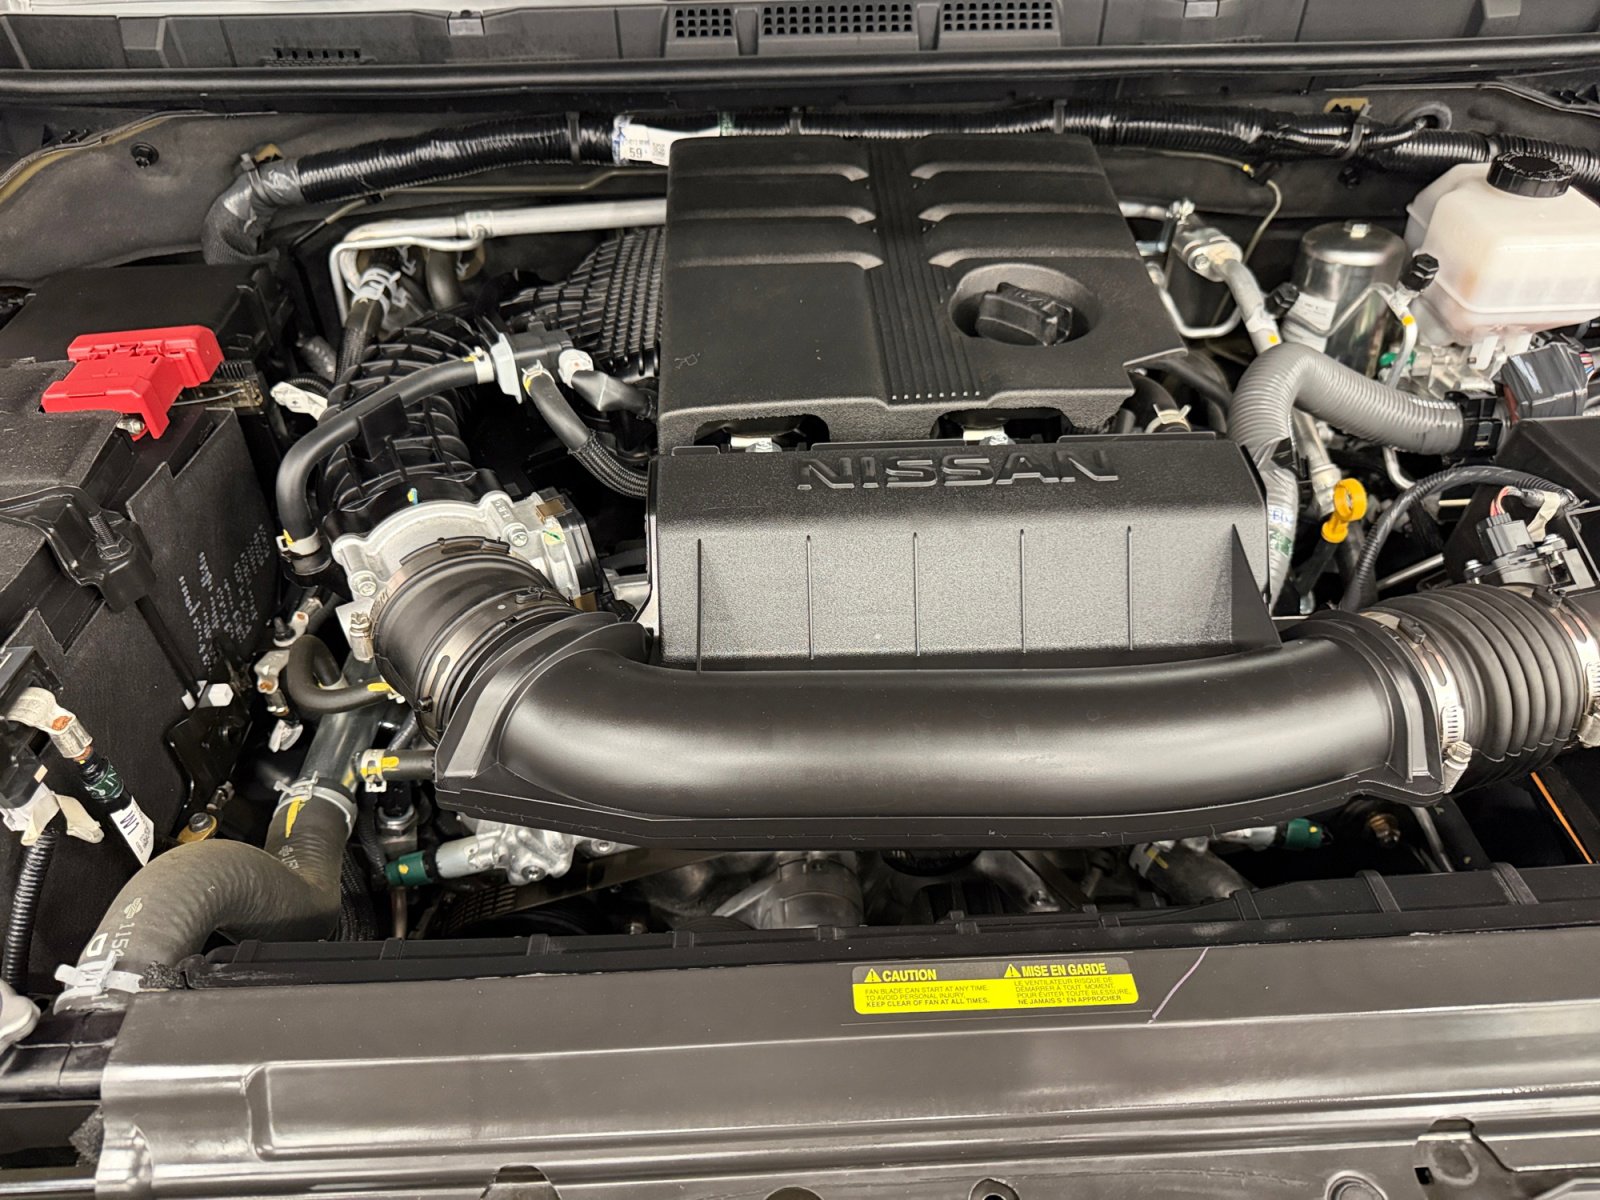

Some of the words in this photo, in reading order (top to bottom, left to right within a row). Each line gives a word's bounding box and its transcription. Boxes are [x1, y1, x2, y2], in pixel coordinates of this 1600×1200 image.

[628, 147, 643, 159] 59
[797, 451, 1119, 490] NISSAN
[882, 969, 937, 982] CAUTION
[1021, 965, 1049, 977] MISE
[1050, 964, 1066, 976] EN
[1067, 963, 1108, 975] GARDE
[1074, 977, 1101, 985] RISQUE
[1078, 995, 1121, 1003] APPROCHER
